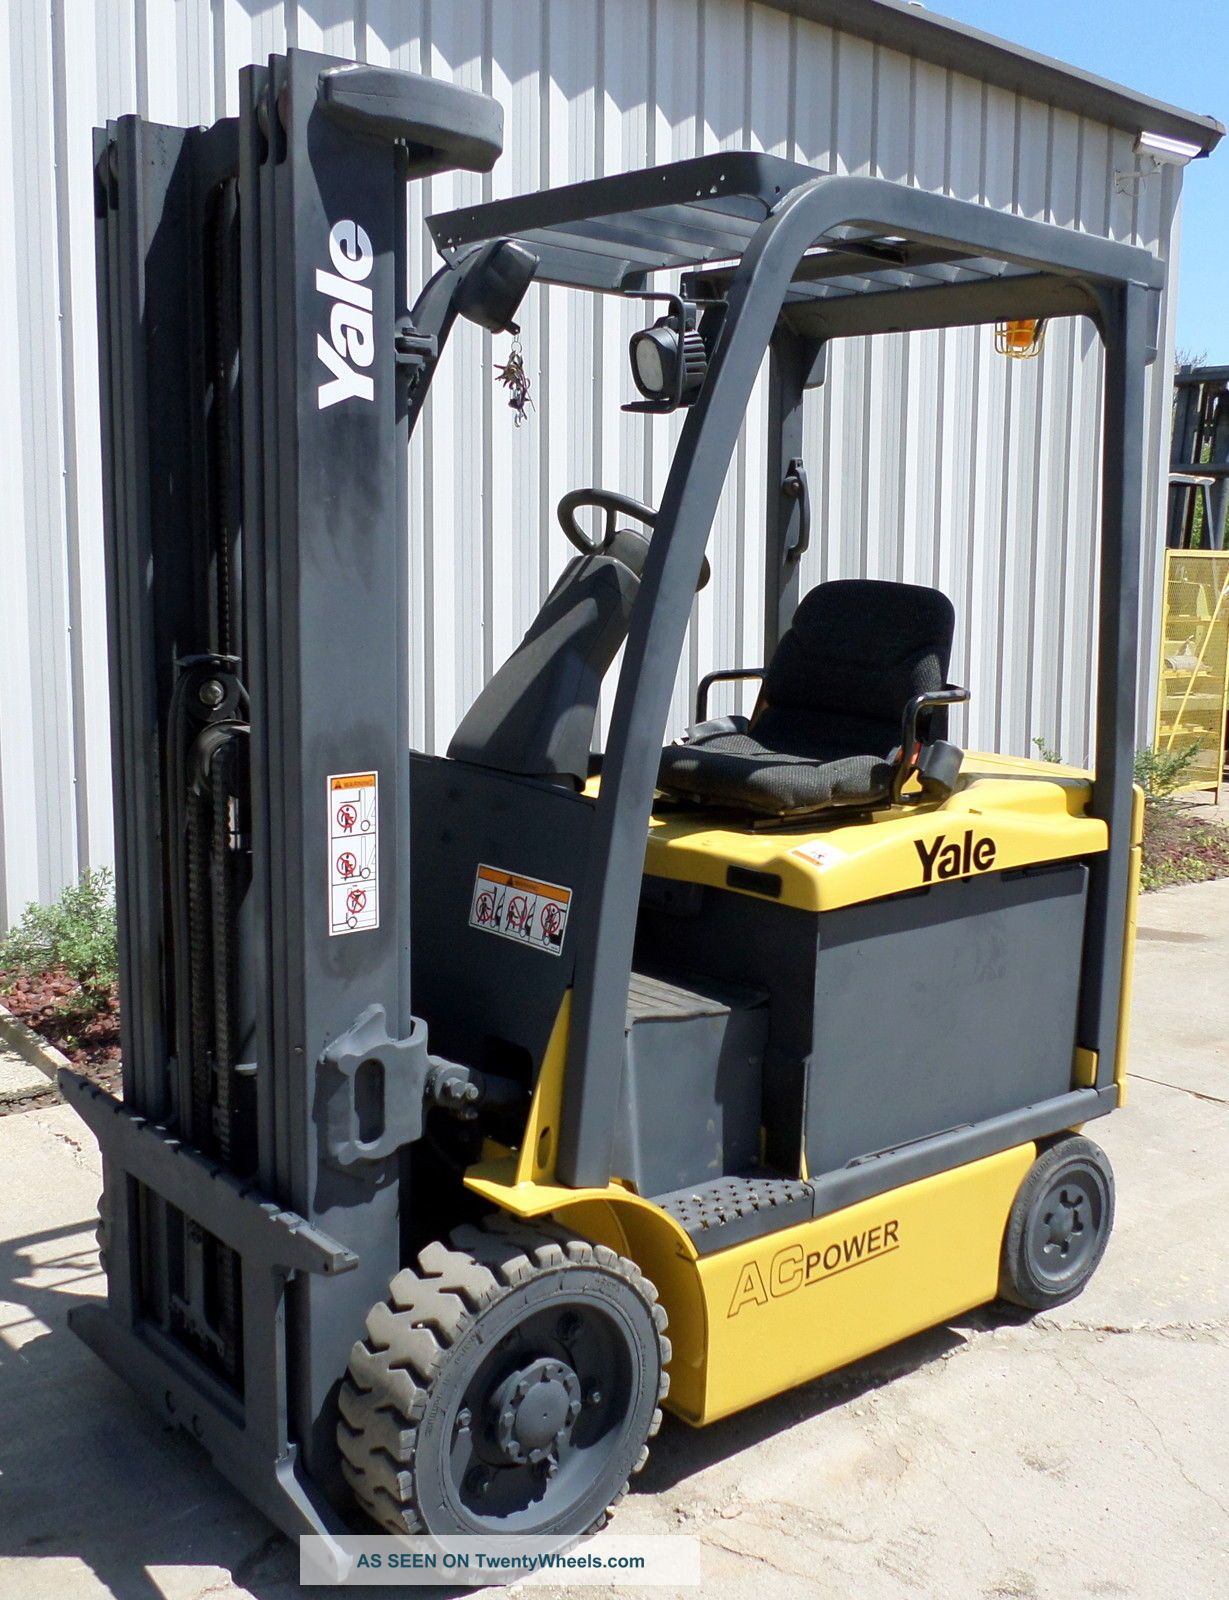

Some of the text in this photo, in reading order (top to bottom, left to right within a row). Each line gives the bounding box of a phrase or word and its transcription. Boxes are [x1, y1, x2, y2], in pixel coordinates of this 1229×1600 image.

[316, 219, 374, 410] Yale
[913, 829, 996, 882] Yale
[727, 1219, 899, 1319] AC POWER
